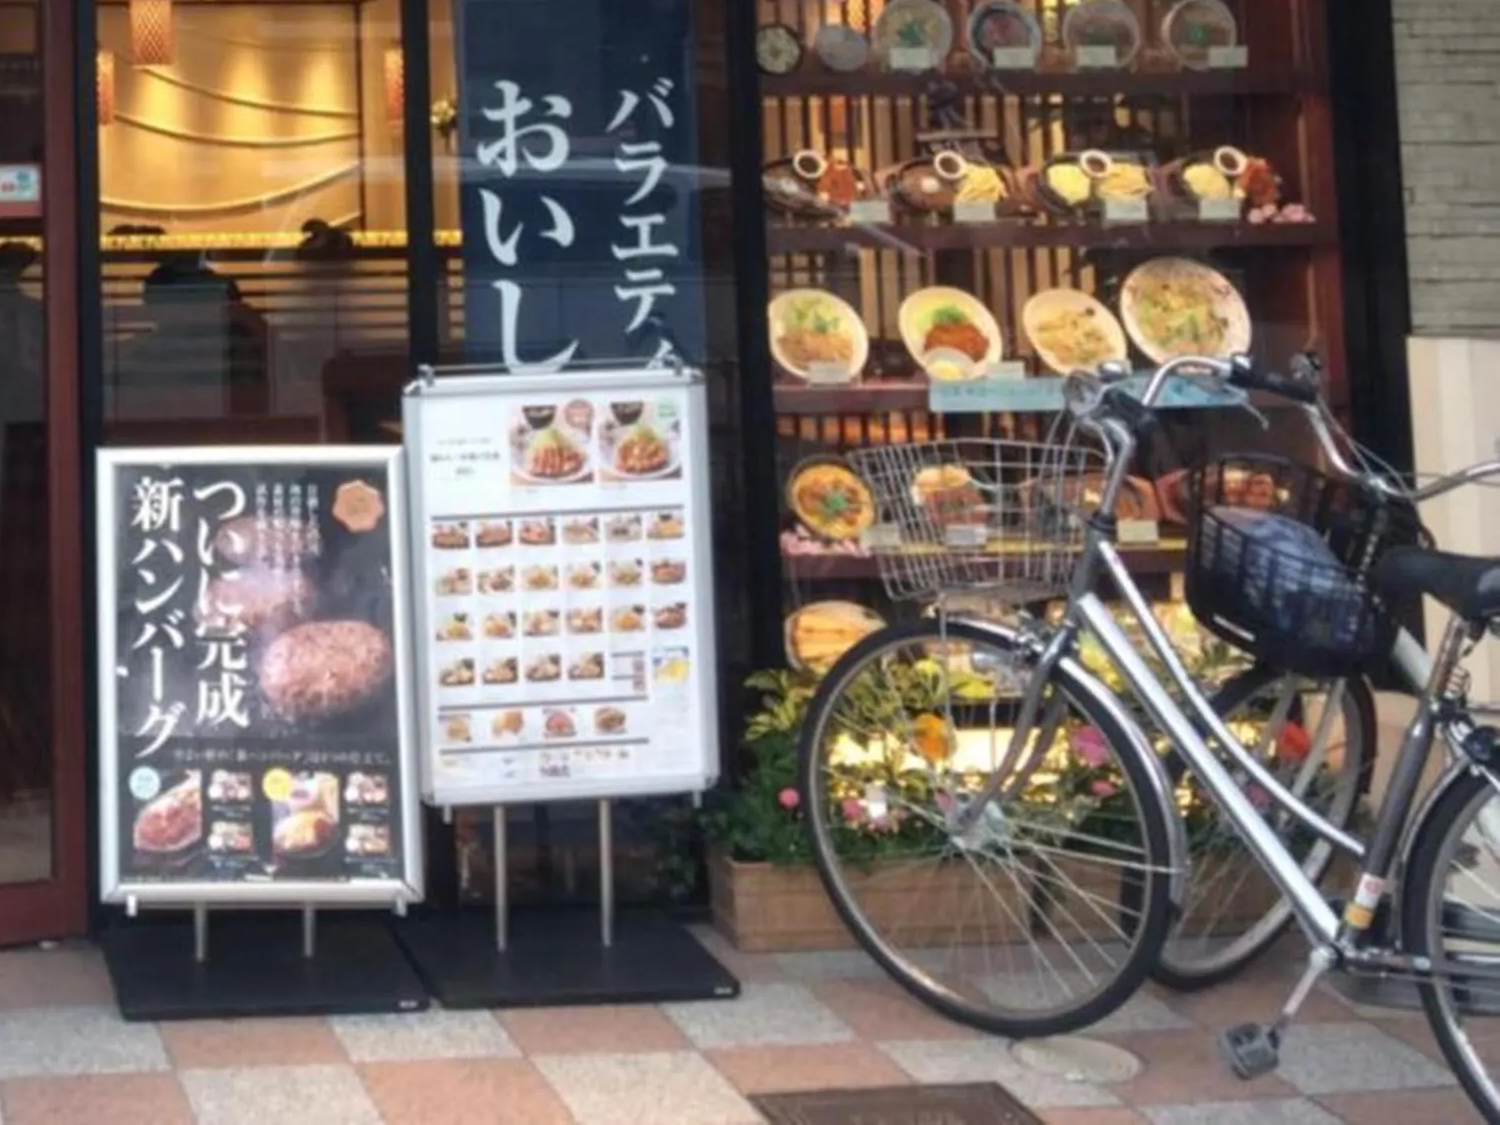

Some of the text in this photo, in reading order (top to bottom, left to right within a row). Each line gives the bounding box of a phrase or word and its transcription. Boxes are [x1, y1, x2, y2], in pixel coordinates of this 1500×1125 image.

[477, 79, 580, 375] おいし
[131, 475, 187, 759] 新ハンバーグ
[192, 480, 249, 727] ついに完成
